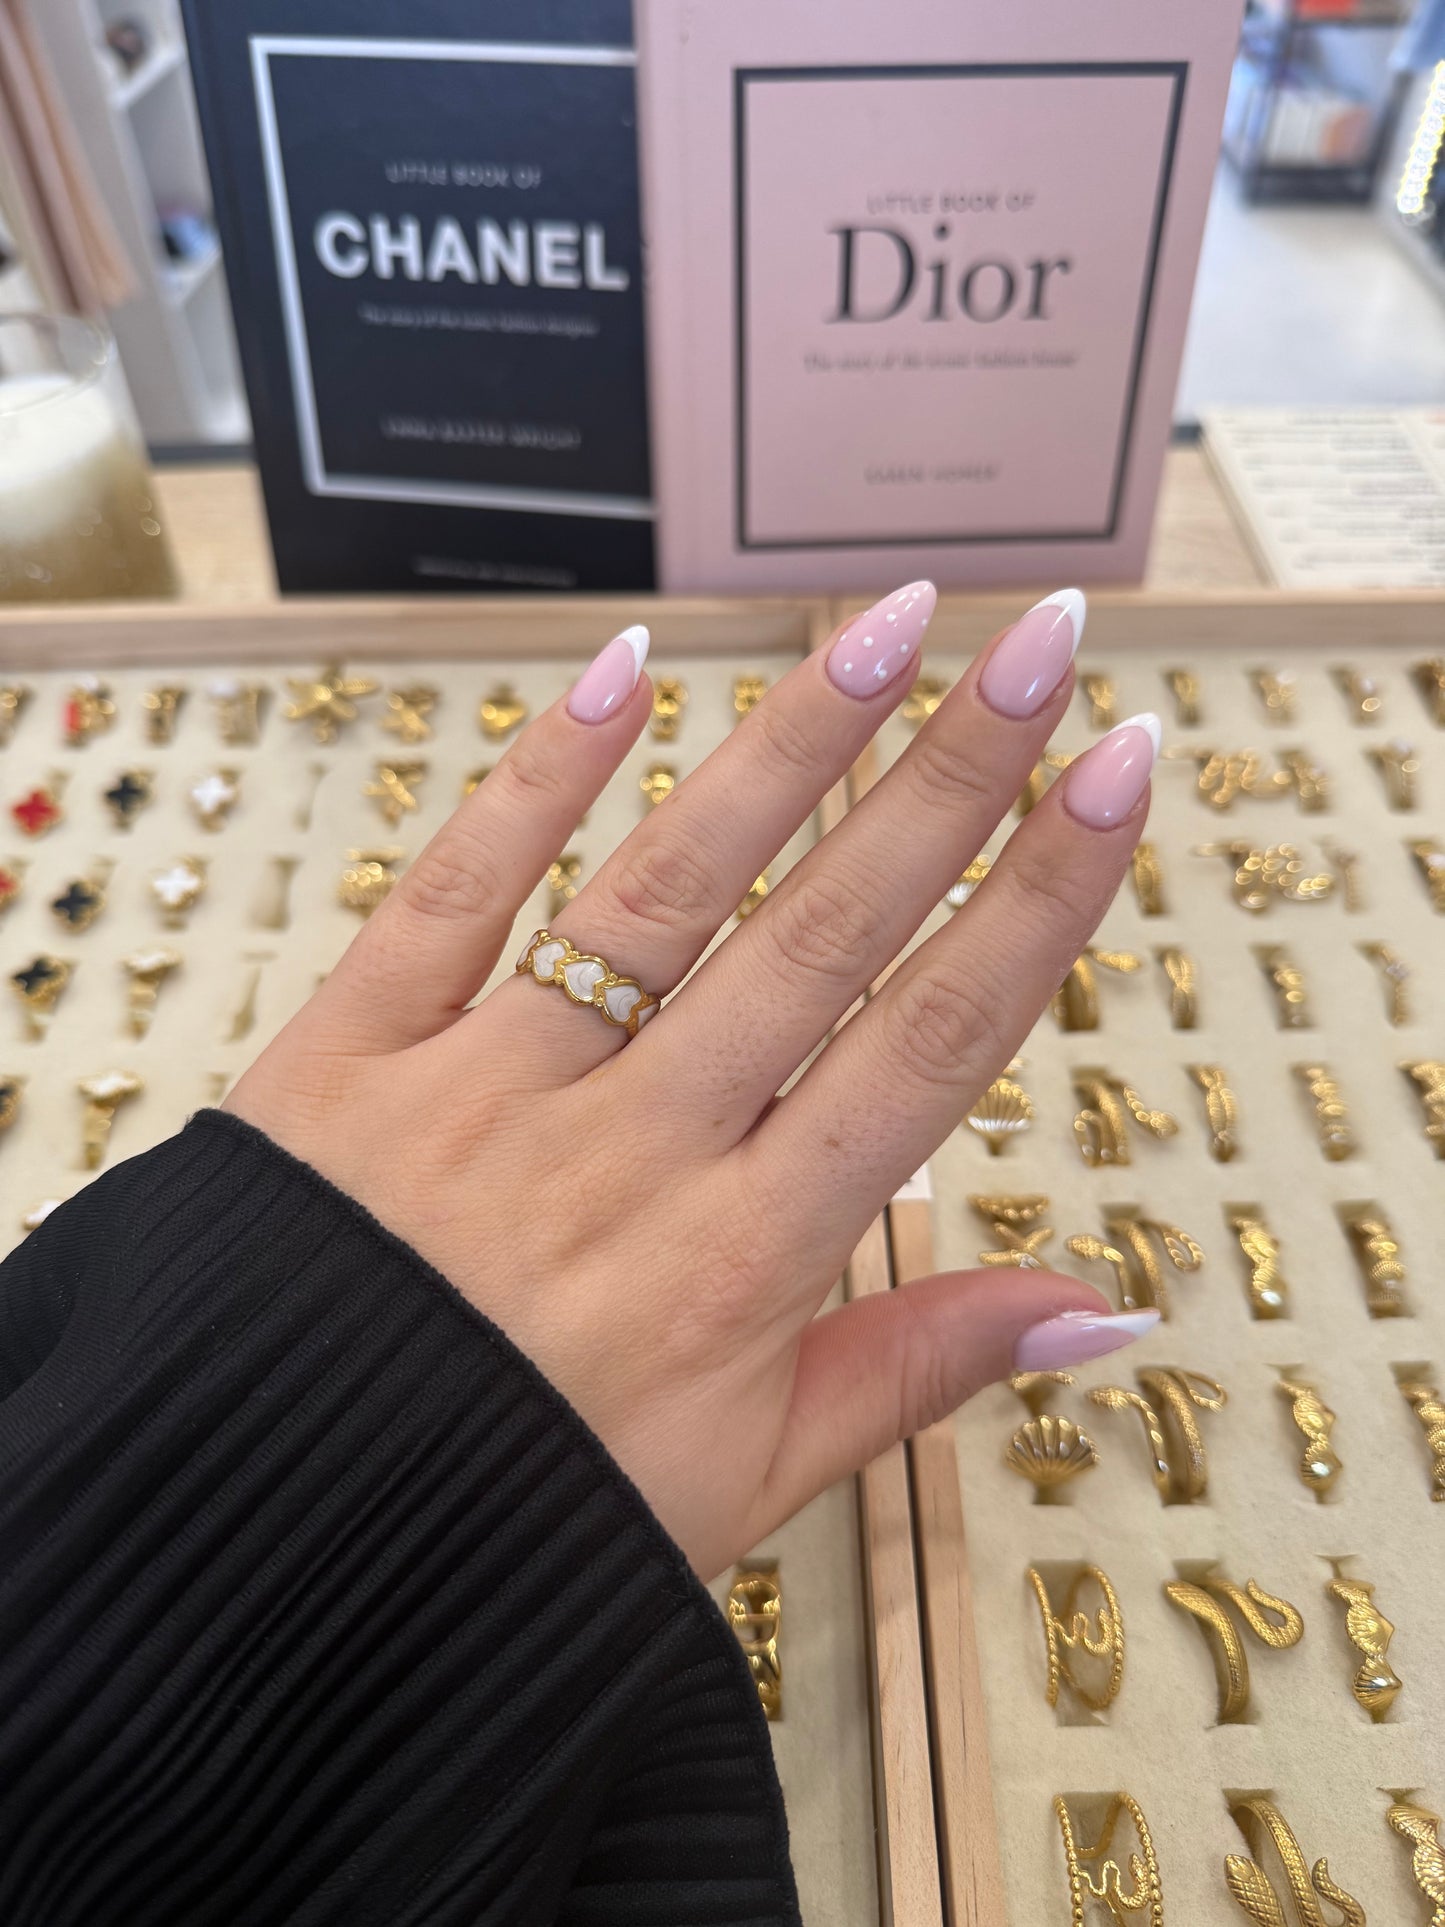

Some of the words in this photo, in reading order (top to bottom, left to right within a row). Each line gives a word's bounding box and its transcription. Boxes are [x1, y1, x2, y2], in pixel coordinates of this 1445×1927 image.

[452, 164, 509, 188] BOOK
[938, 191, 999, 214] BOOK
[1004, 189, 1035, 212] OF
[313, 210, 630, 291] CHANEL
[823, 220, 1075, 325] Dior
